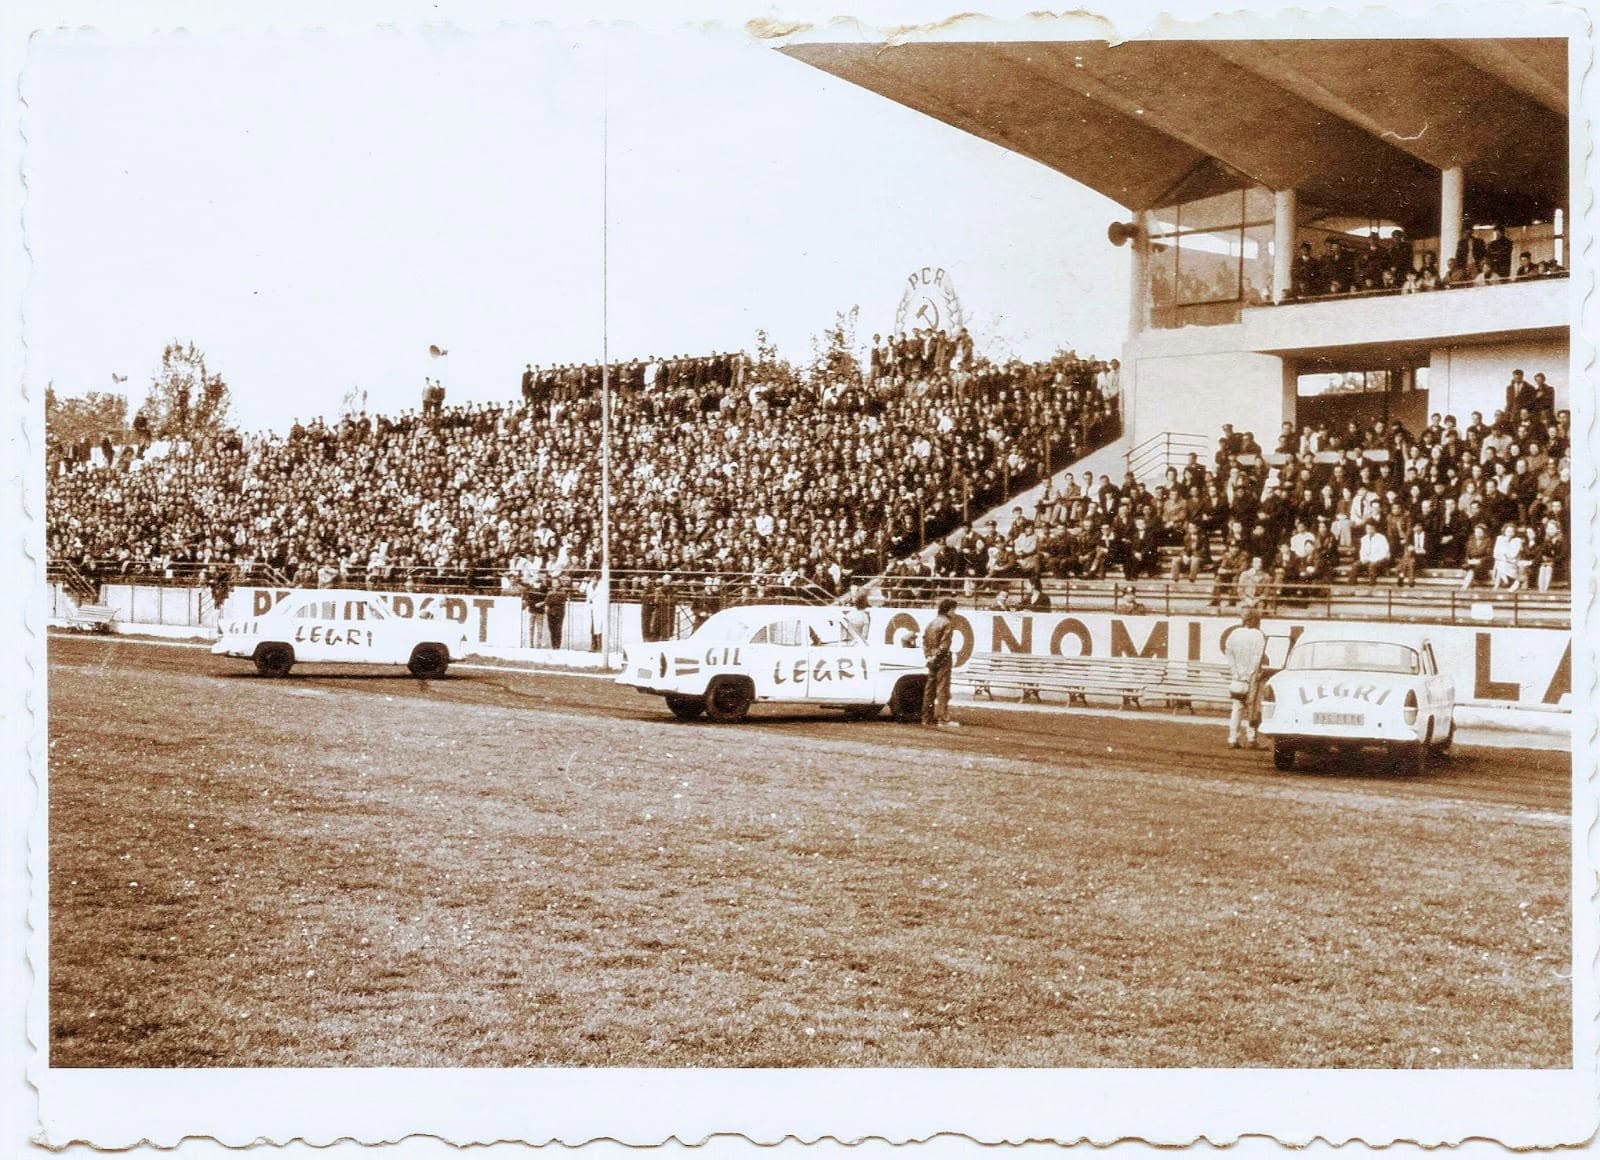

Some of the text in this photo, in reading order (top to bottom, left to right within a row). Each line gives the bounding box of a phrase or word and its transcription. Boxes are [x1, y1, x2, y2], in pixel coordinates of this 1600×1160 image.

[908, 266, 946, 290] PCR
[295, 625, 373, 648] LEGRI
[705, 647, 868, 684] GIL LEGRI
[1299, 684, 1391, 705] LEGRI
